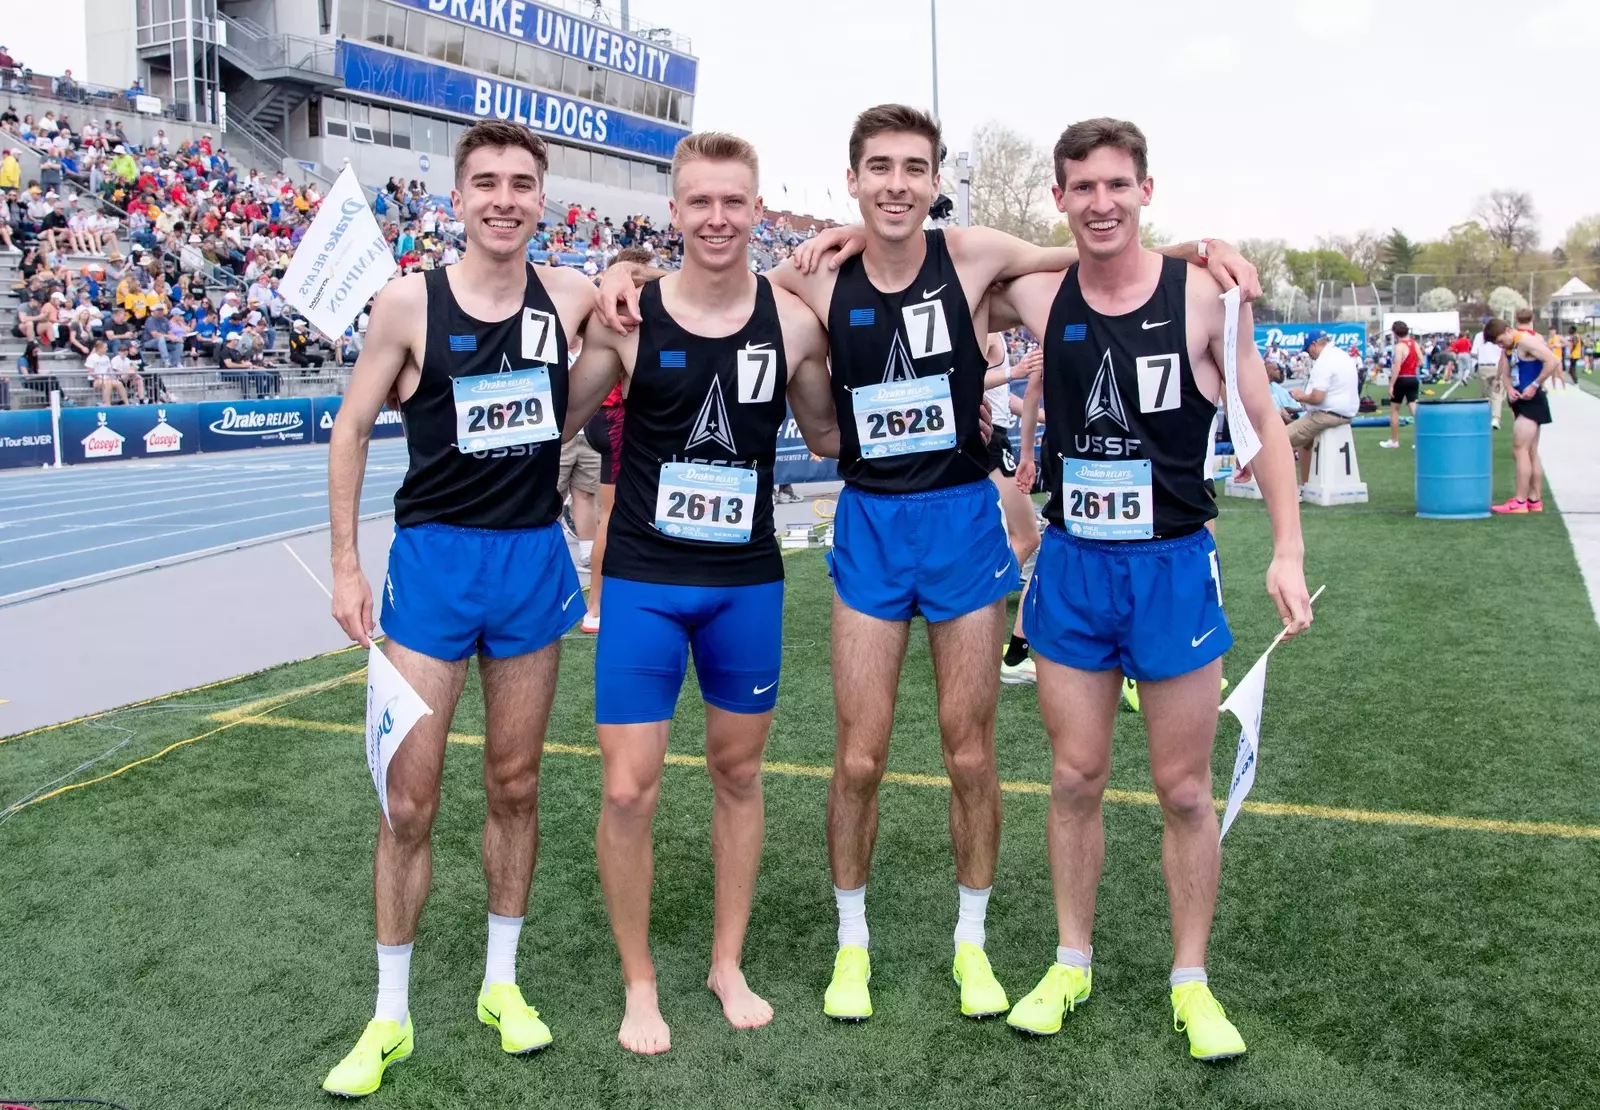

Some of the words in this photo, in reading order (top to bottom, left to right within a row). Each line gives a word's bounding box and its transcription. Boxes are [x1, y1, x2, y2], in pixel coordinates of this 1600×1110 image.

[536, 8, 670, 82] UNIVERSITY
[474, 78, 608, 142] BULLDOGS
[530, 312, 550, 358] 7
[912, 304, 935, 354] 7
[478, 379, 508, 391] Drake
[746, 353, 770, 400] 7
[876, 387, 907, 399] Drake
[1146, 358, 1172, 409] 7
[220, 406, 266, 430] Drake
[266, 411, 300, 426] RELAYS
[467, 397, 544, 433] 2629
[866, 404, 945, 440] 2628
[4, 436, 22, 447] Tour
[22, 434, 52, 446] SILVER
[88, 437, 120, 452] Casey's
[149, 433, 178, 448] Casey's
[1074, 434, 1142, 456] USSF
[685, 468, 715, 481] Drake
[1080, 465, 1105, 478] Drake
[1105, 470, 1132, 478] RELAYS
[1313, 441, 1320, 476] 1
[1339, 441, 1351, 476] 1
[666, 491, 744, 525] 2613
[1070, 489, 1141, 520] 2615
